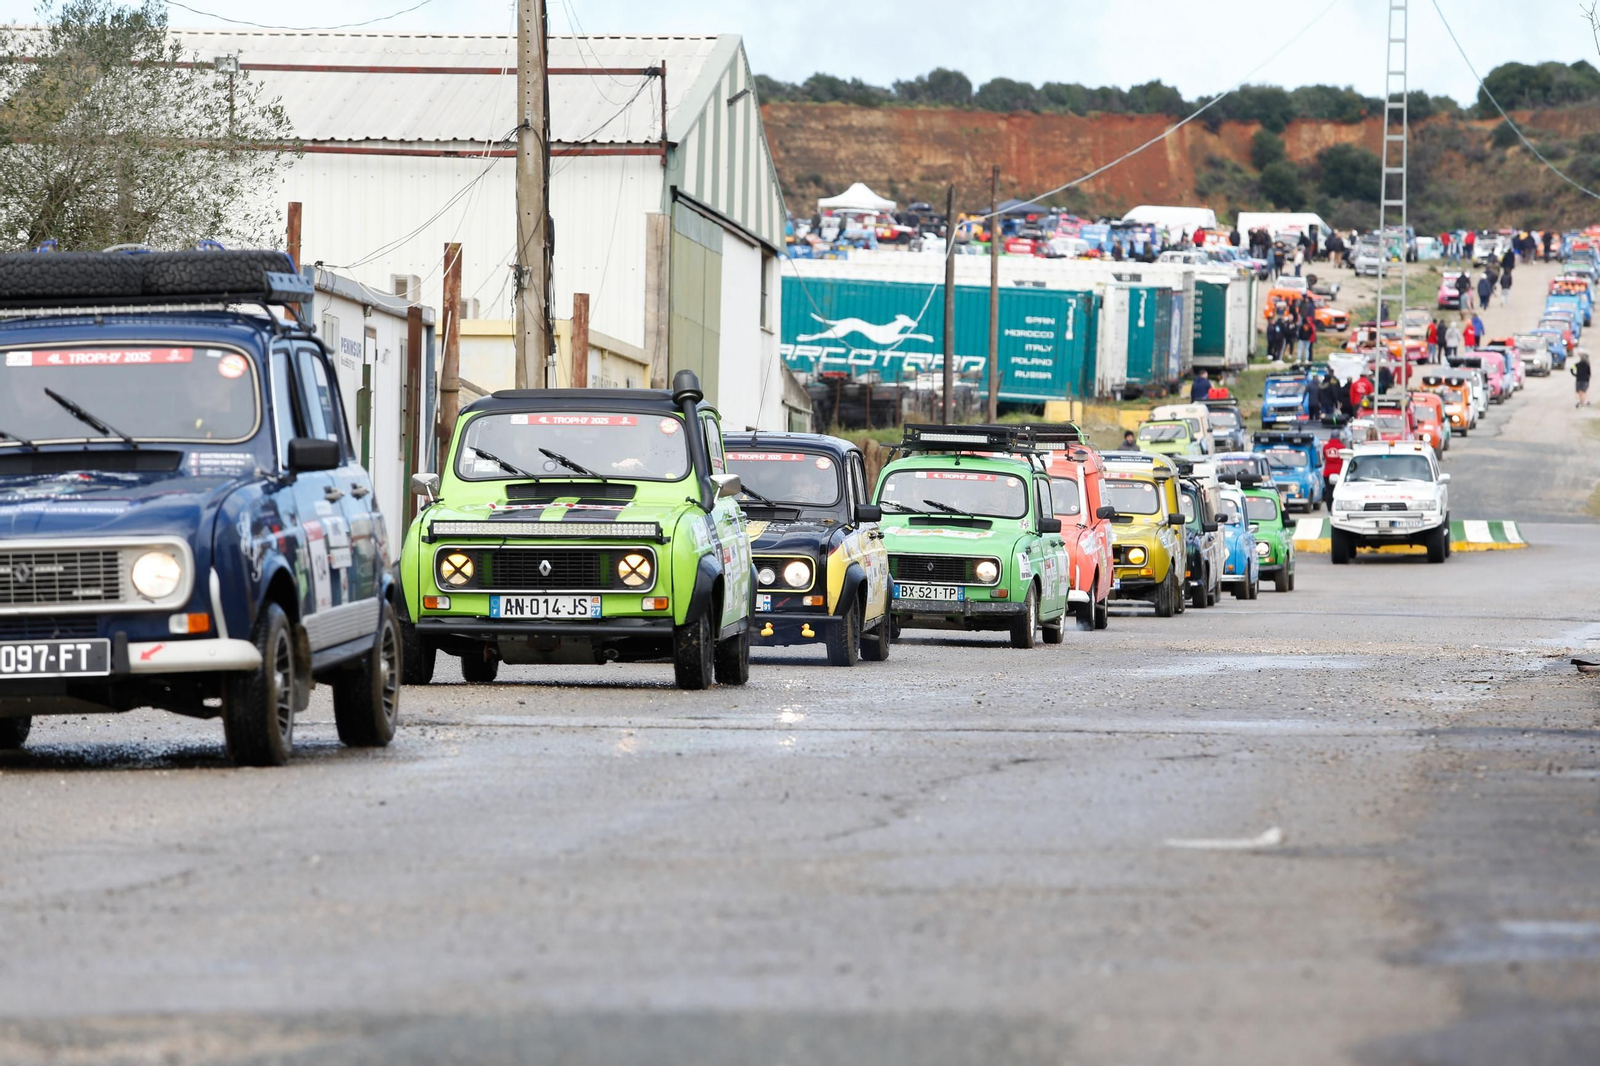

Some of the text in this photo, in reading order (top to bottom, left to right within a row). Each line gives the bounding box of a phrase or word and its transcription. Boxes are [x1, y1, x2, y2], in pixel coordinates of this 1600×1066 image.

[1025, 316, 1055, 325] SPAIN
[1004, 329, 1054, 339] MOROCCO
[1024, 343, 1053, 352] ITALY
[46, 351, 152, 364] 4L TROPHY 2025
[1011, 356, 1053, 367] POLAND
[1014, 370, 1052, 380] RUSSIA
[901, 586, 956, 599] BX-521-TP
[504, 598, 588, 616] AN-014-JS
[591, 607, 600, 616] 27
